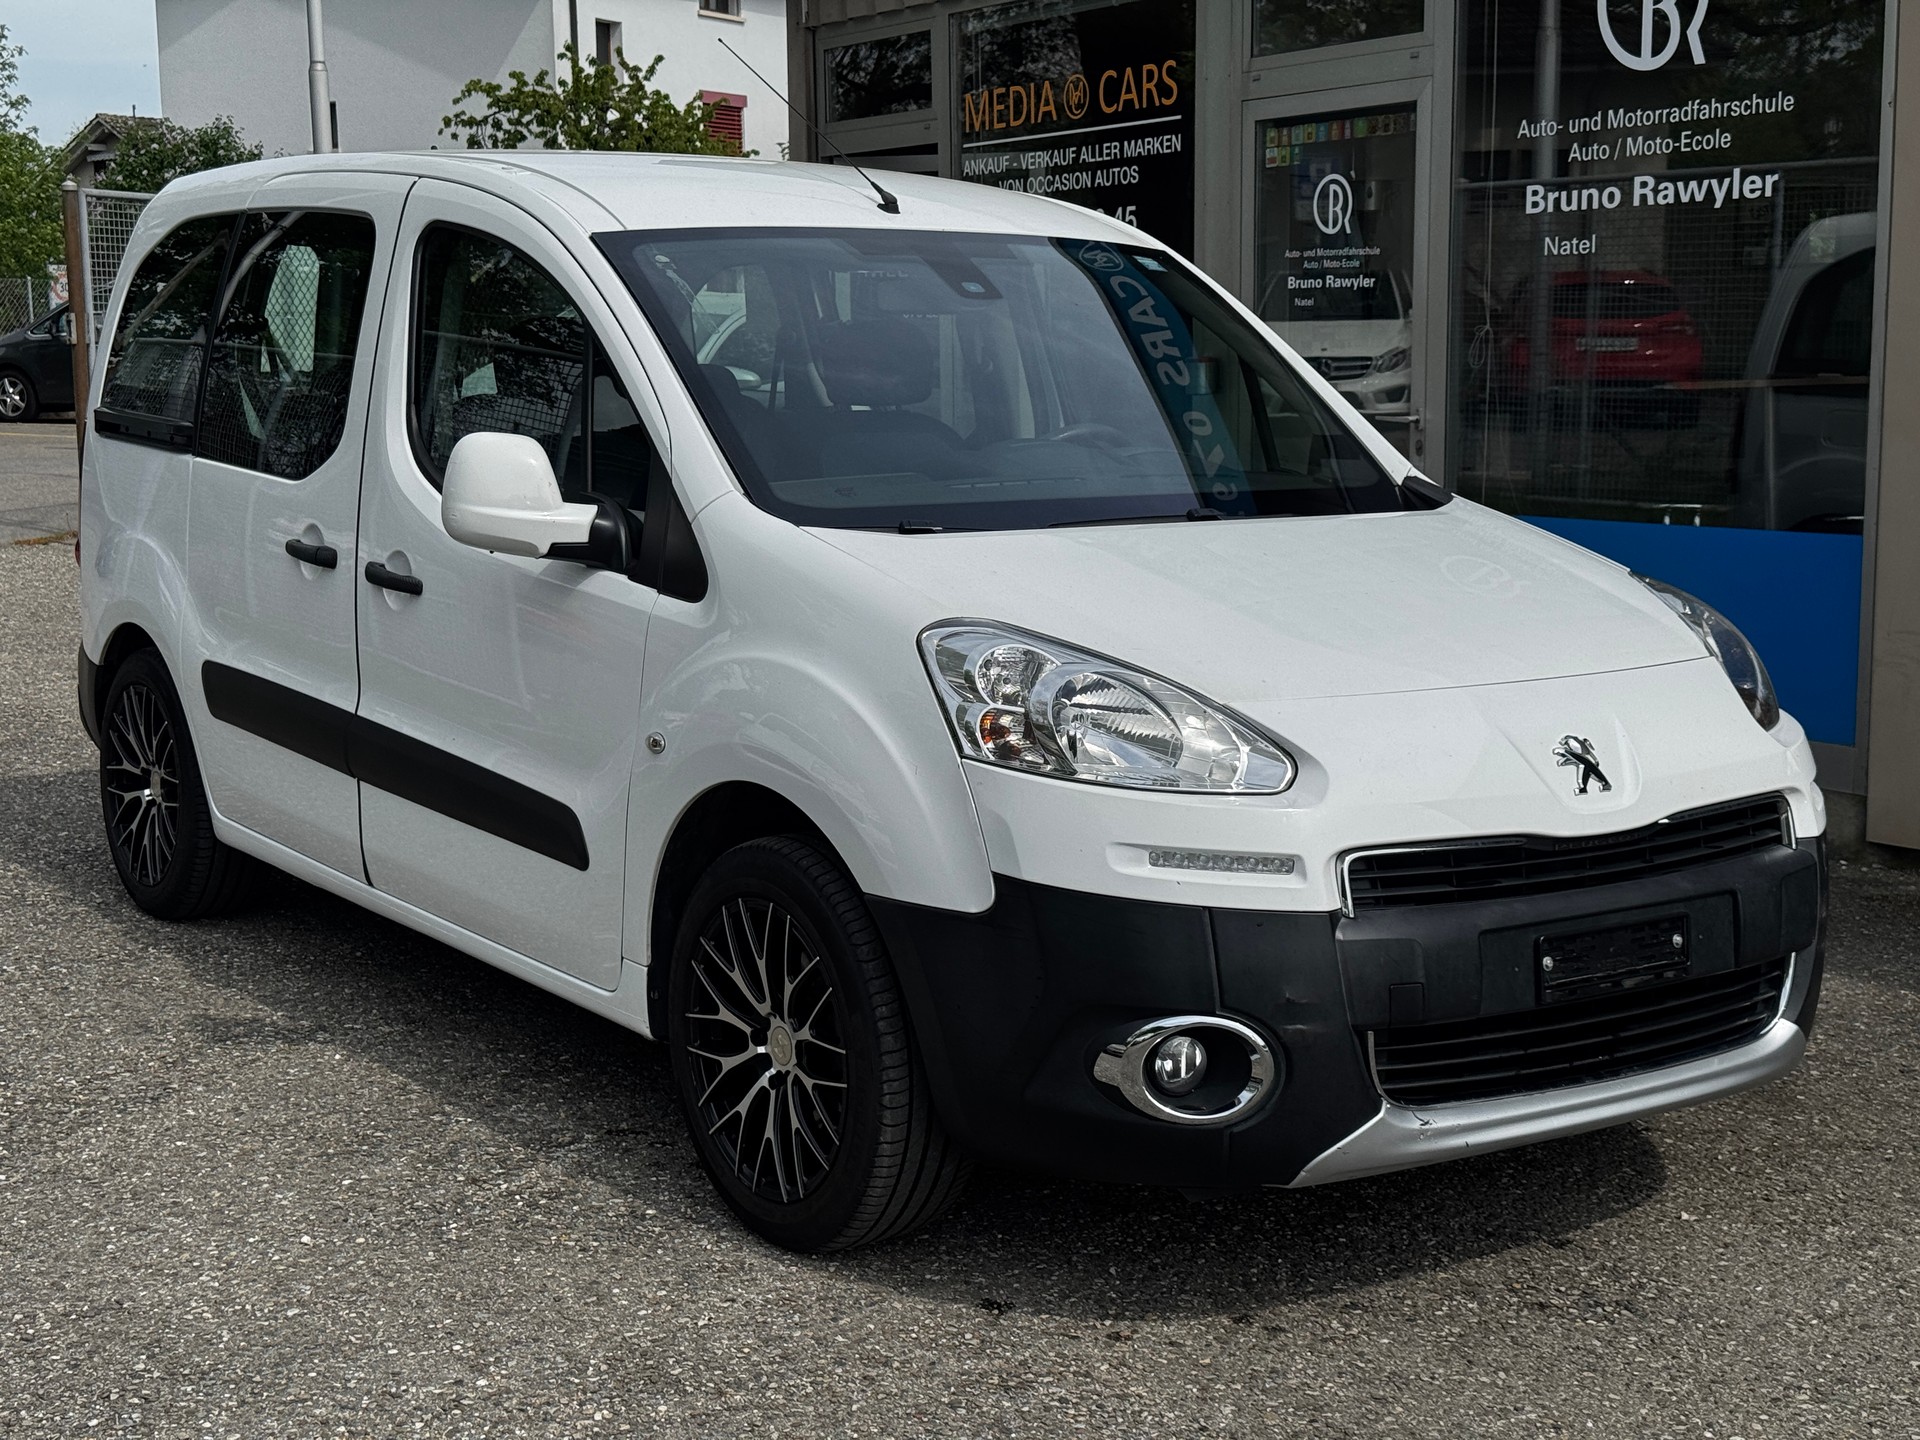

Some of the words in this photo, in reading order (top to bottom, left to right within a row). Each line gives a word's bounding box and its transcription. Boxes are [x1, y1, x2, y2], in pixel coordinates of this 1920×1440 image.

[965, 80, 1057, 133] MEDIA
[1099, 60, 1178, 114] CARS
[1517, 118, 1563, 139] Auto-
[1568, 110, 1601, 134] und
[1606, 91, 1795, 130] Motorradfahrschule
[963, 156, 1010, 177] ANKAUF
[1020, 147, 1077, 170] VERKAUF
[1079, 142, 1121, 163] ALLER
[1123, 134, 1182, 157] MARKEN
[1568, 141, 1610, 163] Auto
[1613, 139, 1622, 160] /
[1625, 129, 1732, 157] Moto-Ecole
[998, 178, 1024, 193] VON
[1026, 171, 1092, 194] OCCASION
[1094, 165, 1140, 188] AUTOS
[1525, 184, 1621, 215] Bruno
[1632, 167, 1779, 209] Rawyler
[1284, 249, 1303, 258] Auto-
[1303, 248, 1316, 257] und
[1544, 234, 1597, 256] Natel
[1303, 260, 1319, 269] Auto
[1323, 258, 1361, 269] Moto-Ecole
[1287, 275, 1323, 290] Bruno
[1325, 274, 1376, 291] Rawyler
[1294, 297, 1315, 307] Natel
